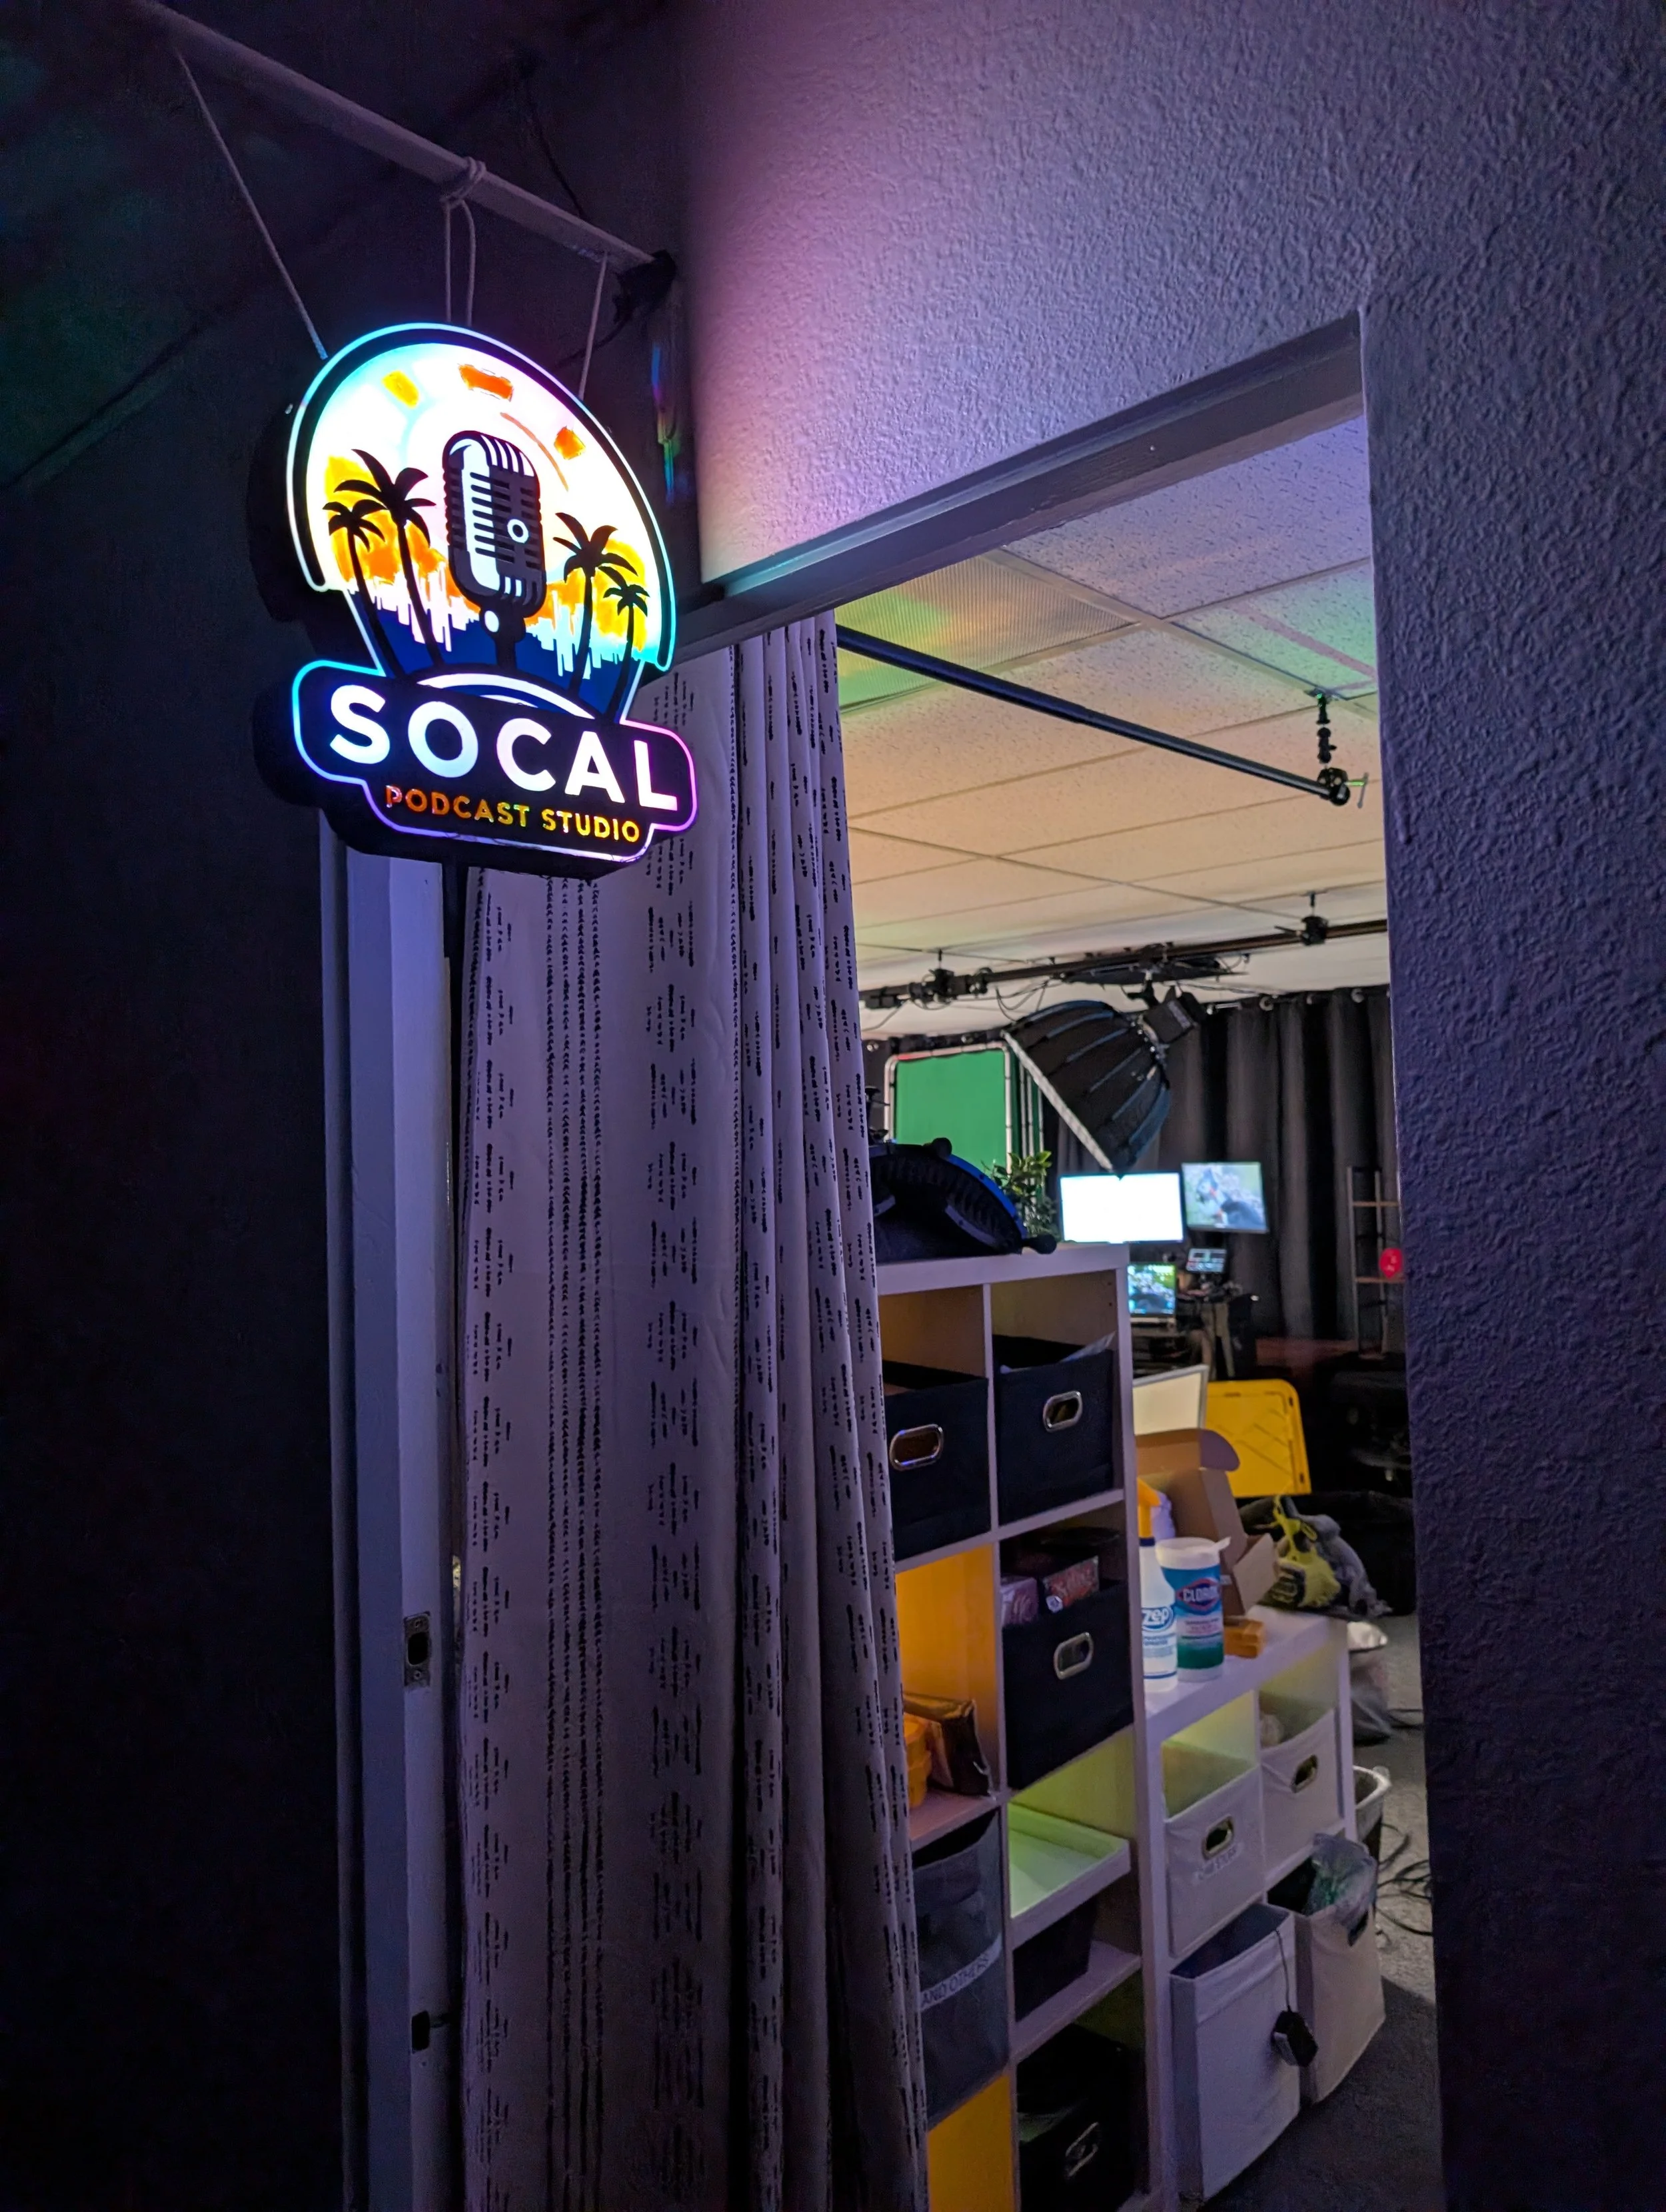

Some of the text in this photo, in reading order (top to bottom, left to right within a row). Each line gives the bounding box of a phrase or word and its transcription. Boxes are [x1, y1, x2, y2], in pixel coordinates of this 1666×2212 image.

[330, 684, 678, 812] SOCAL
[385, 784, 640, 843] PODCAST STUDIO
